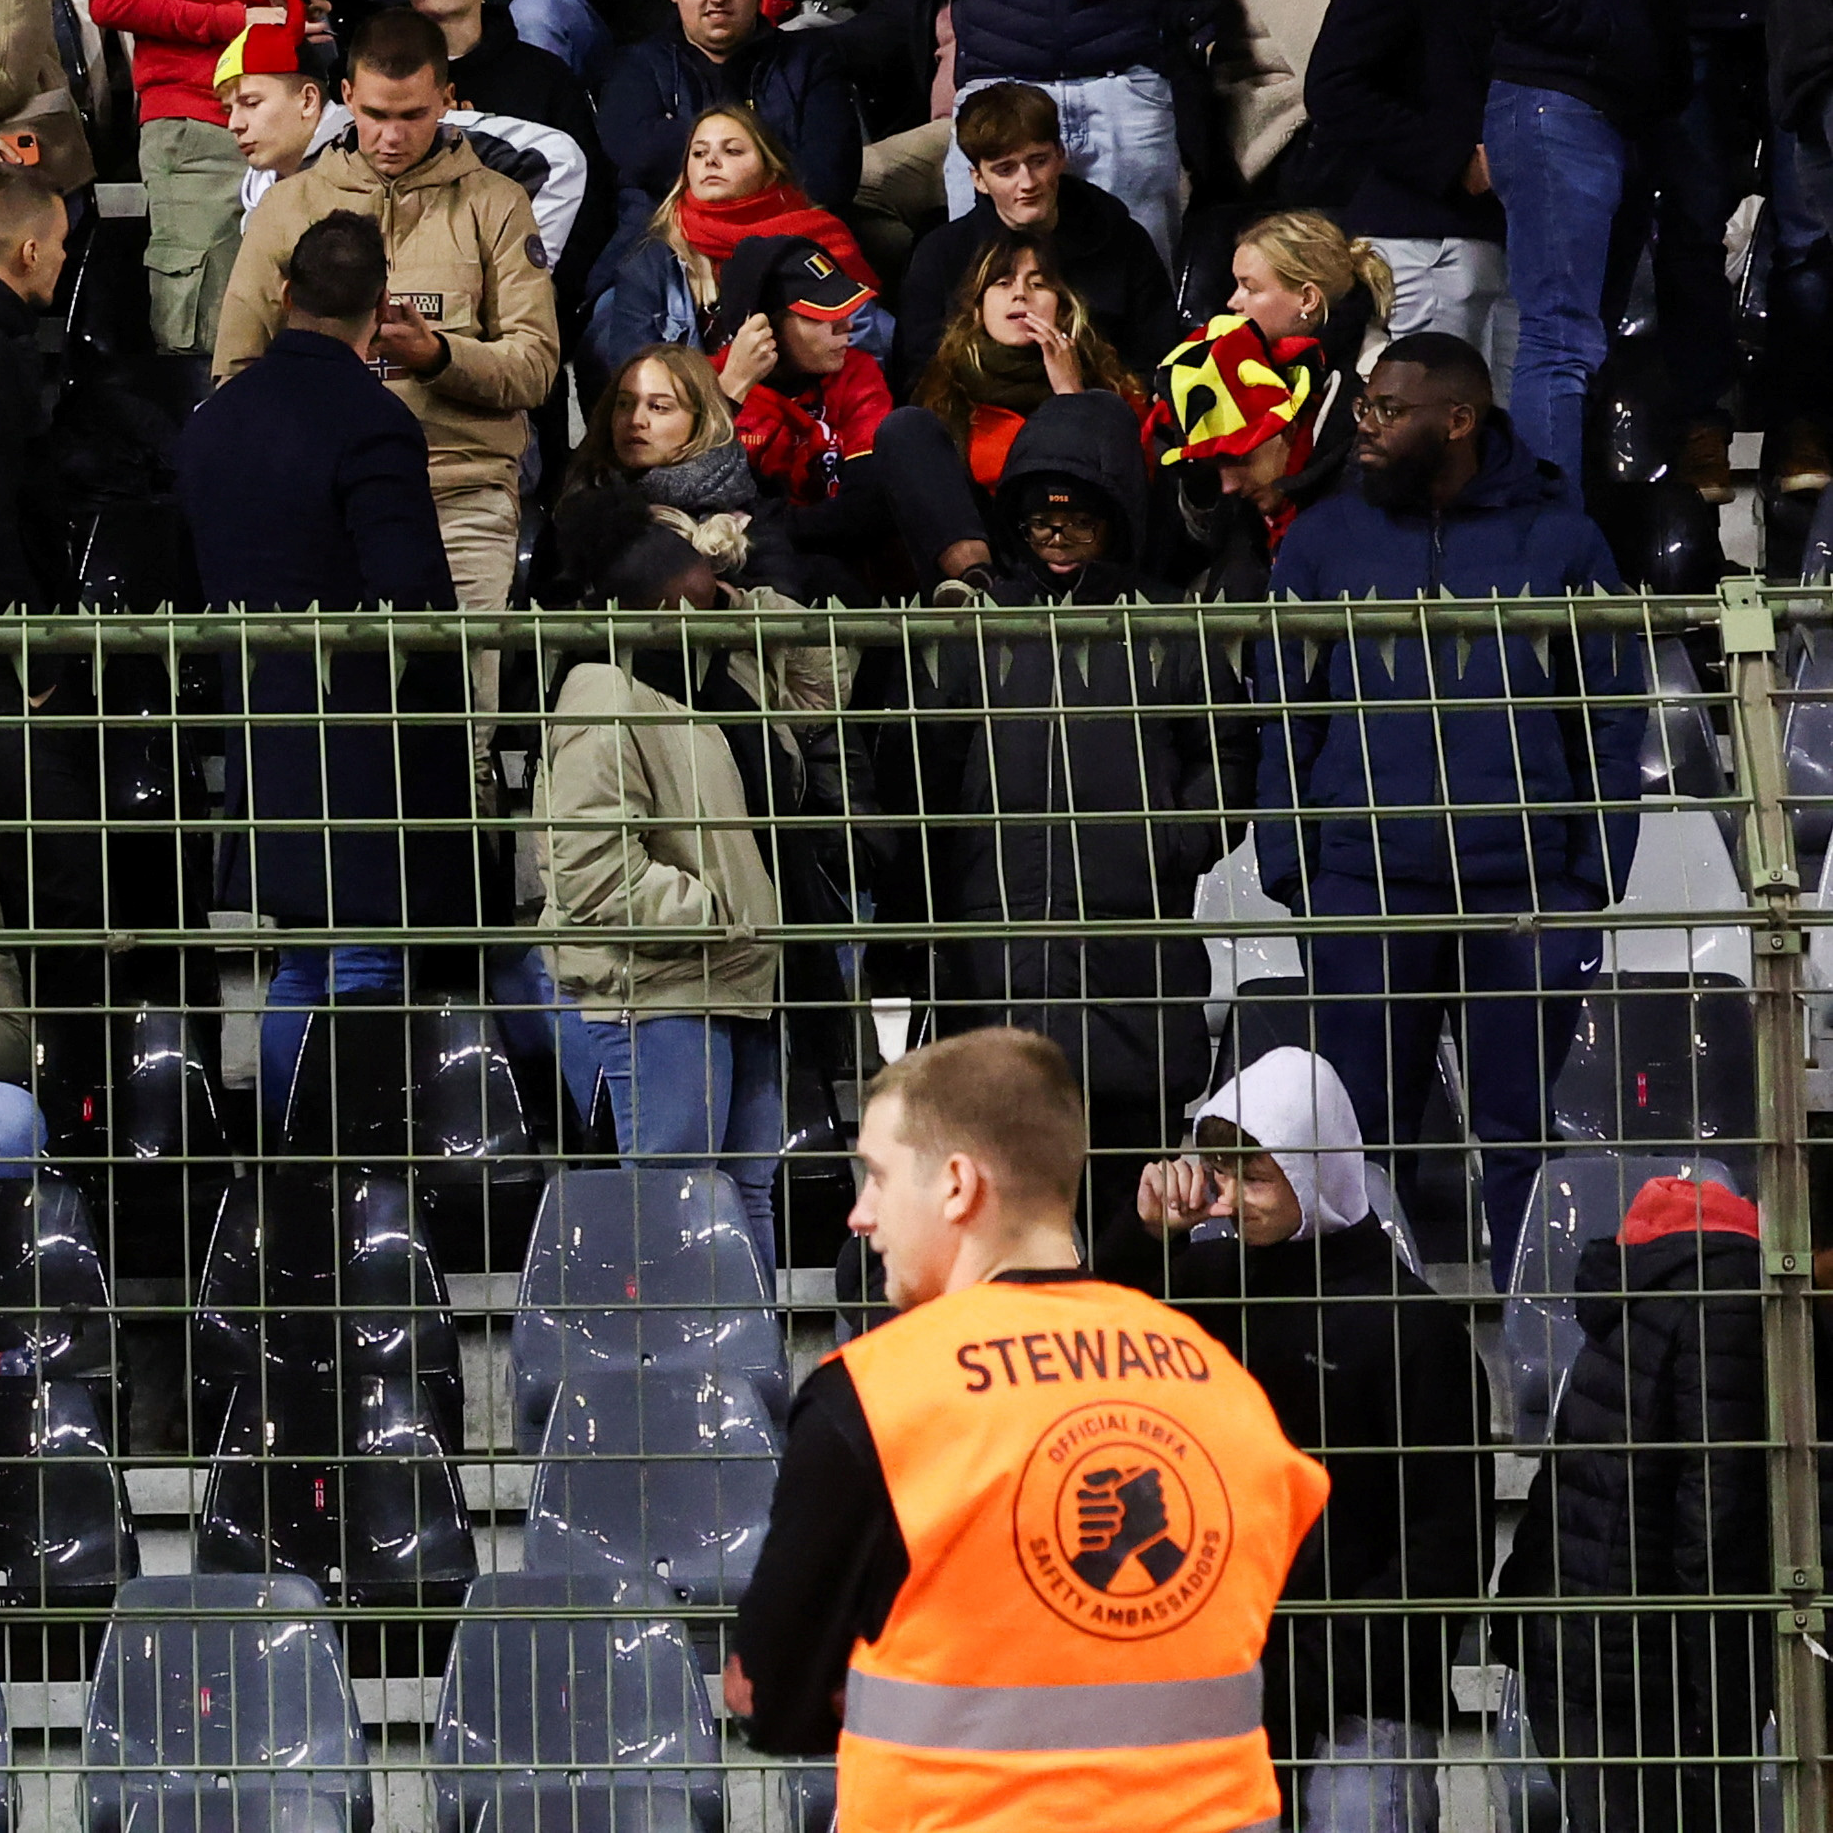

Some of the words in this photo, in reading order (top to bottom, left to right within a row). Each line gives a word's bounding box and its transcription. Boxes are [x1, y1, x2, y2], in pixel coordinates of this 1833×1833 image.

[956, 1328, 1211, 1394] STEWARD
[1047, 1414, 1129, 1464] OFFICIAL
[1030, 1536, 1089, 1612] SAFETY
[1090, 1529, 1221, 1628] AMBASSADORS
